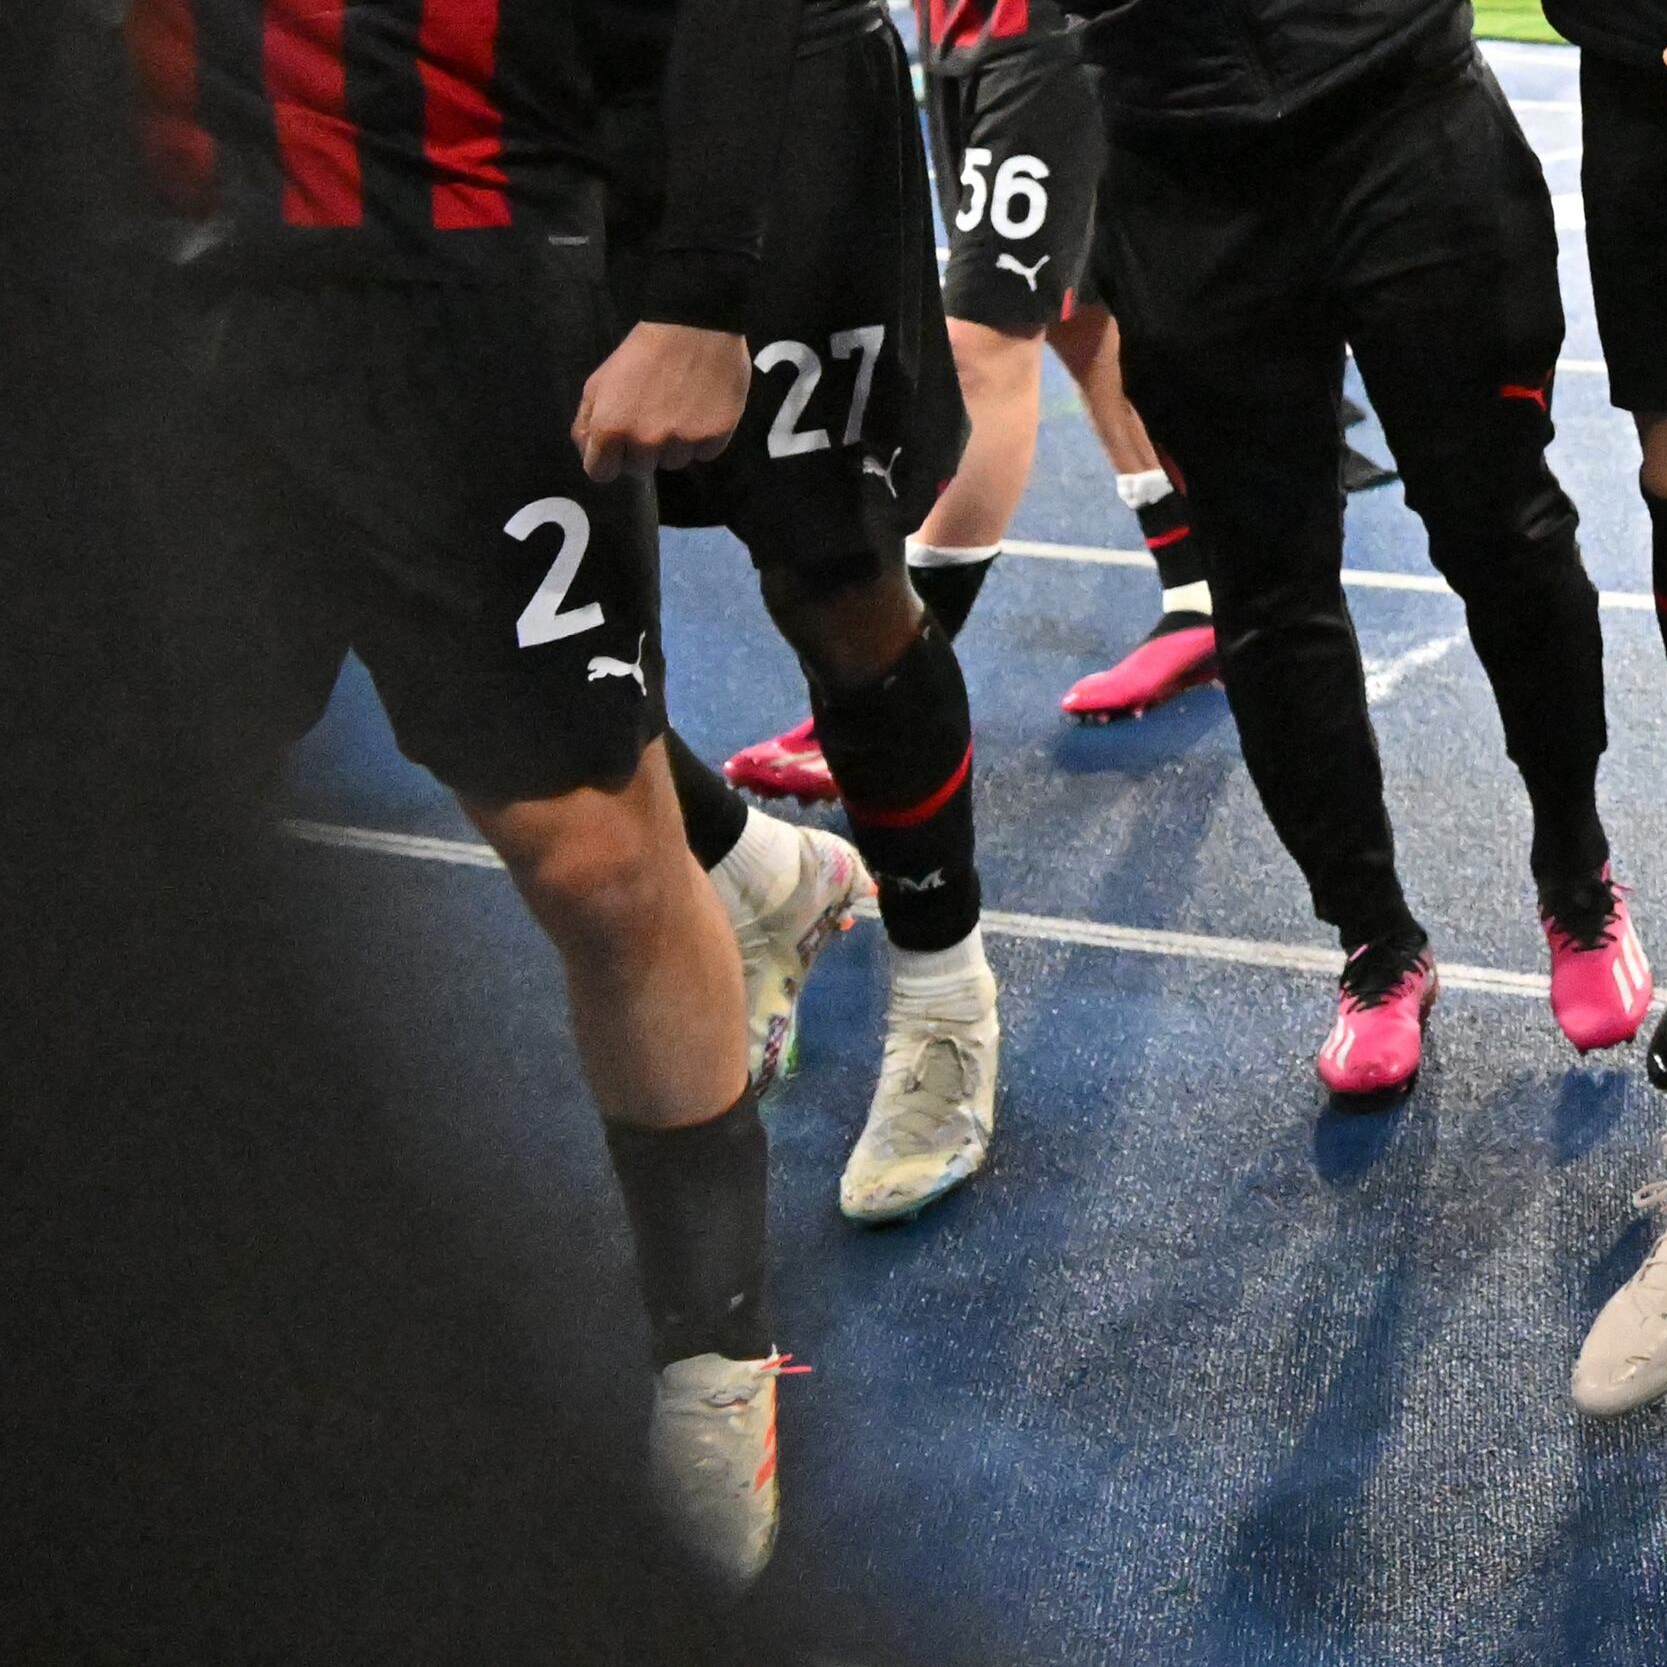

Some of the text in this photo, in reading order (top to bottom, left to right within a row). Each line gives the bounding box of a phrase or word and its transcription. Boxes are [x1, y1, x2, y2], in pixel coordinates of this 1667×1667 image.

[955, 148, 1050, 239] 56
[753, 325, 885, 459] 27
[503, 496, 605, 648] 2
